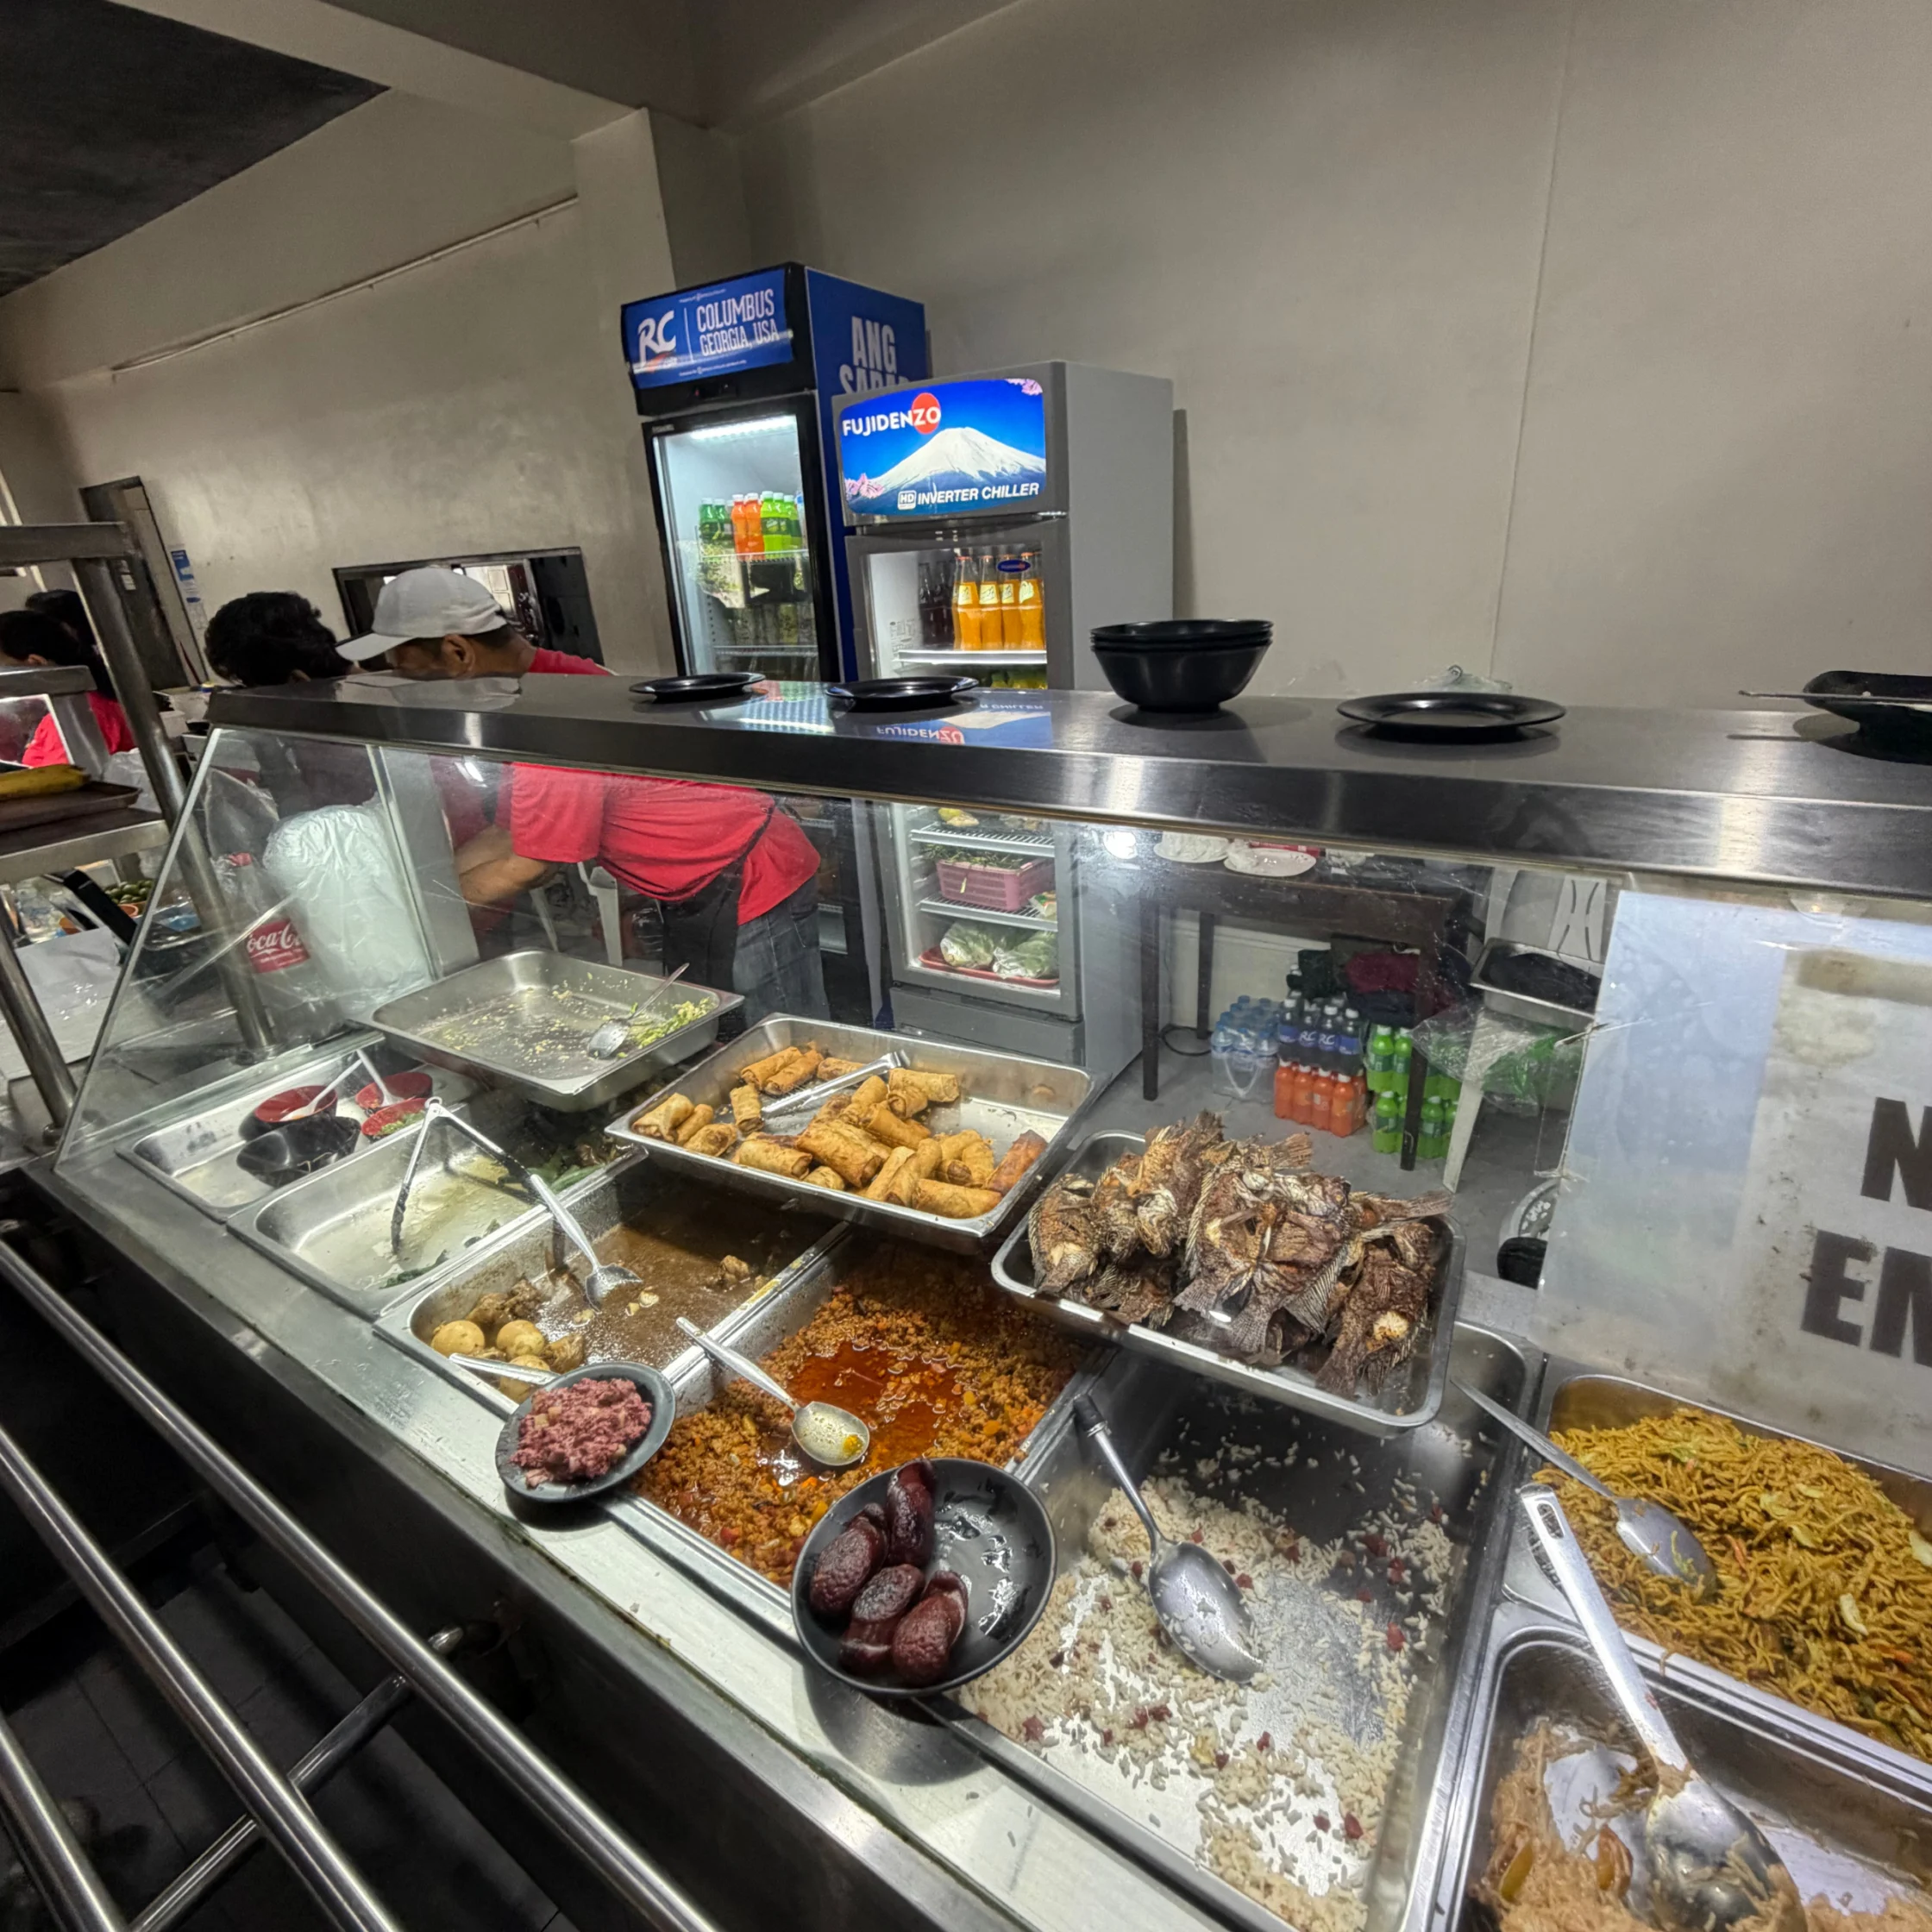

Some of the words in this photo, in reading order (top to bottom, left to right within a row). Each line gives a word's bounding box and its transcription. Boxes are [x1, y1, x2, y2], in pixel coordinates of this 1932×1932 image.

[696, 288, 775, 333] COLUMBUS
[637, 310, 677, 368] RC
[699, 325, 753, 357] GEORGIA,
[753, 318, 781, 344] USA
[851, 315, 897, 374] ANG
[842, 406, 942, 436] FUJIDENZO
[900, 492, 915, 504] HD
[917, 486, 979, 505] INVERTER
[982, 482, 1040, 499] CHILLER
[1299, 1030, 1317, 1042] RC
[1318, 1032, 1336, 1045] RC
